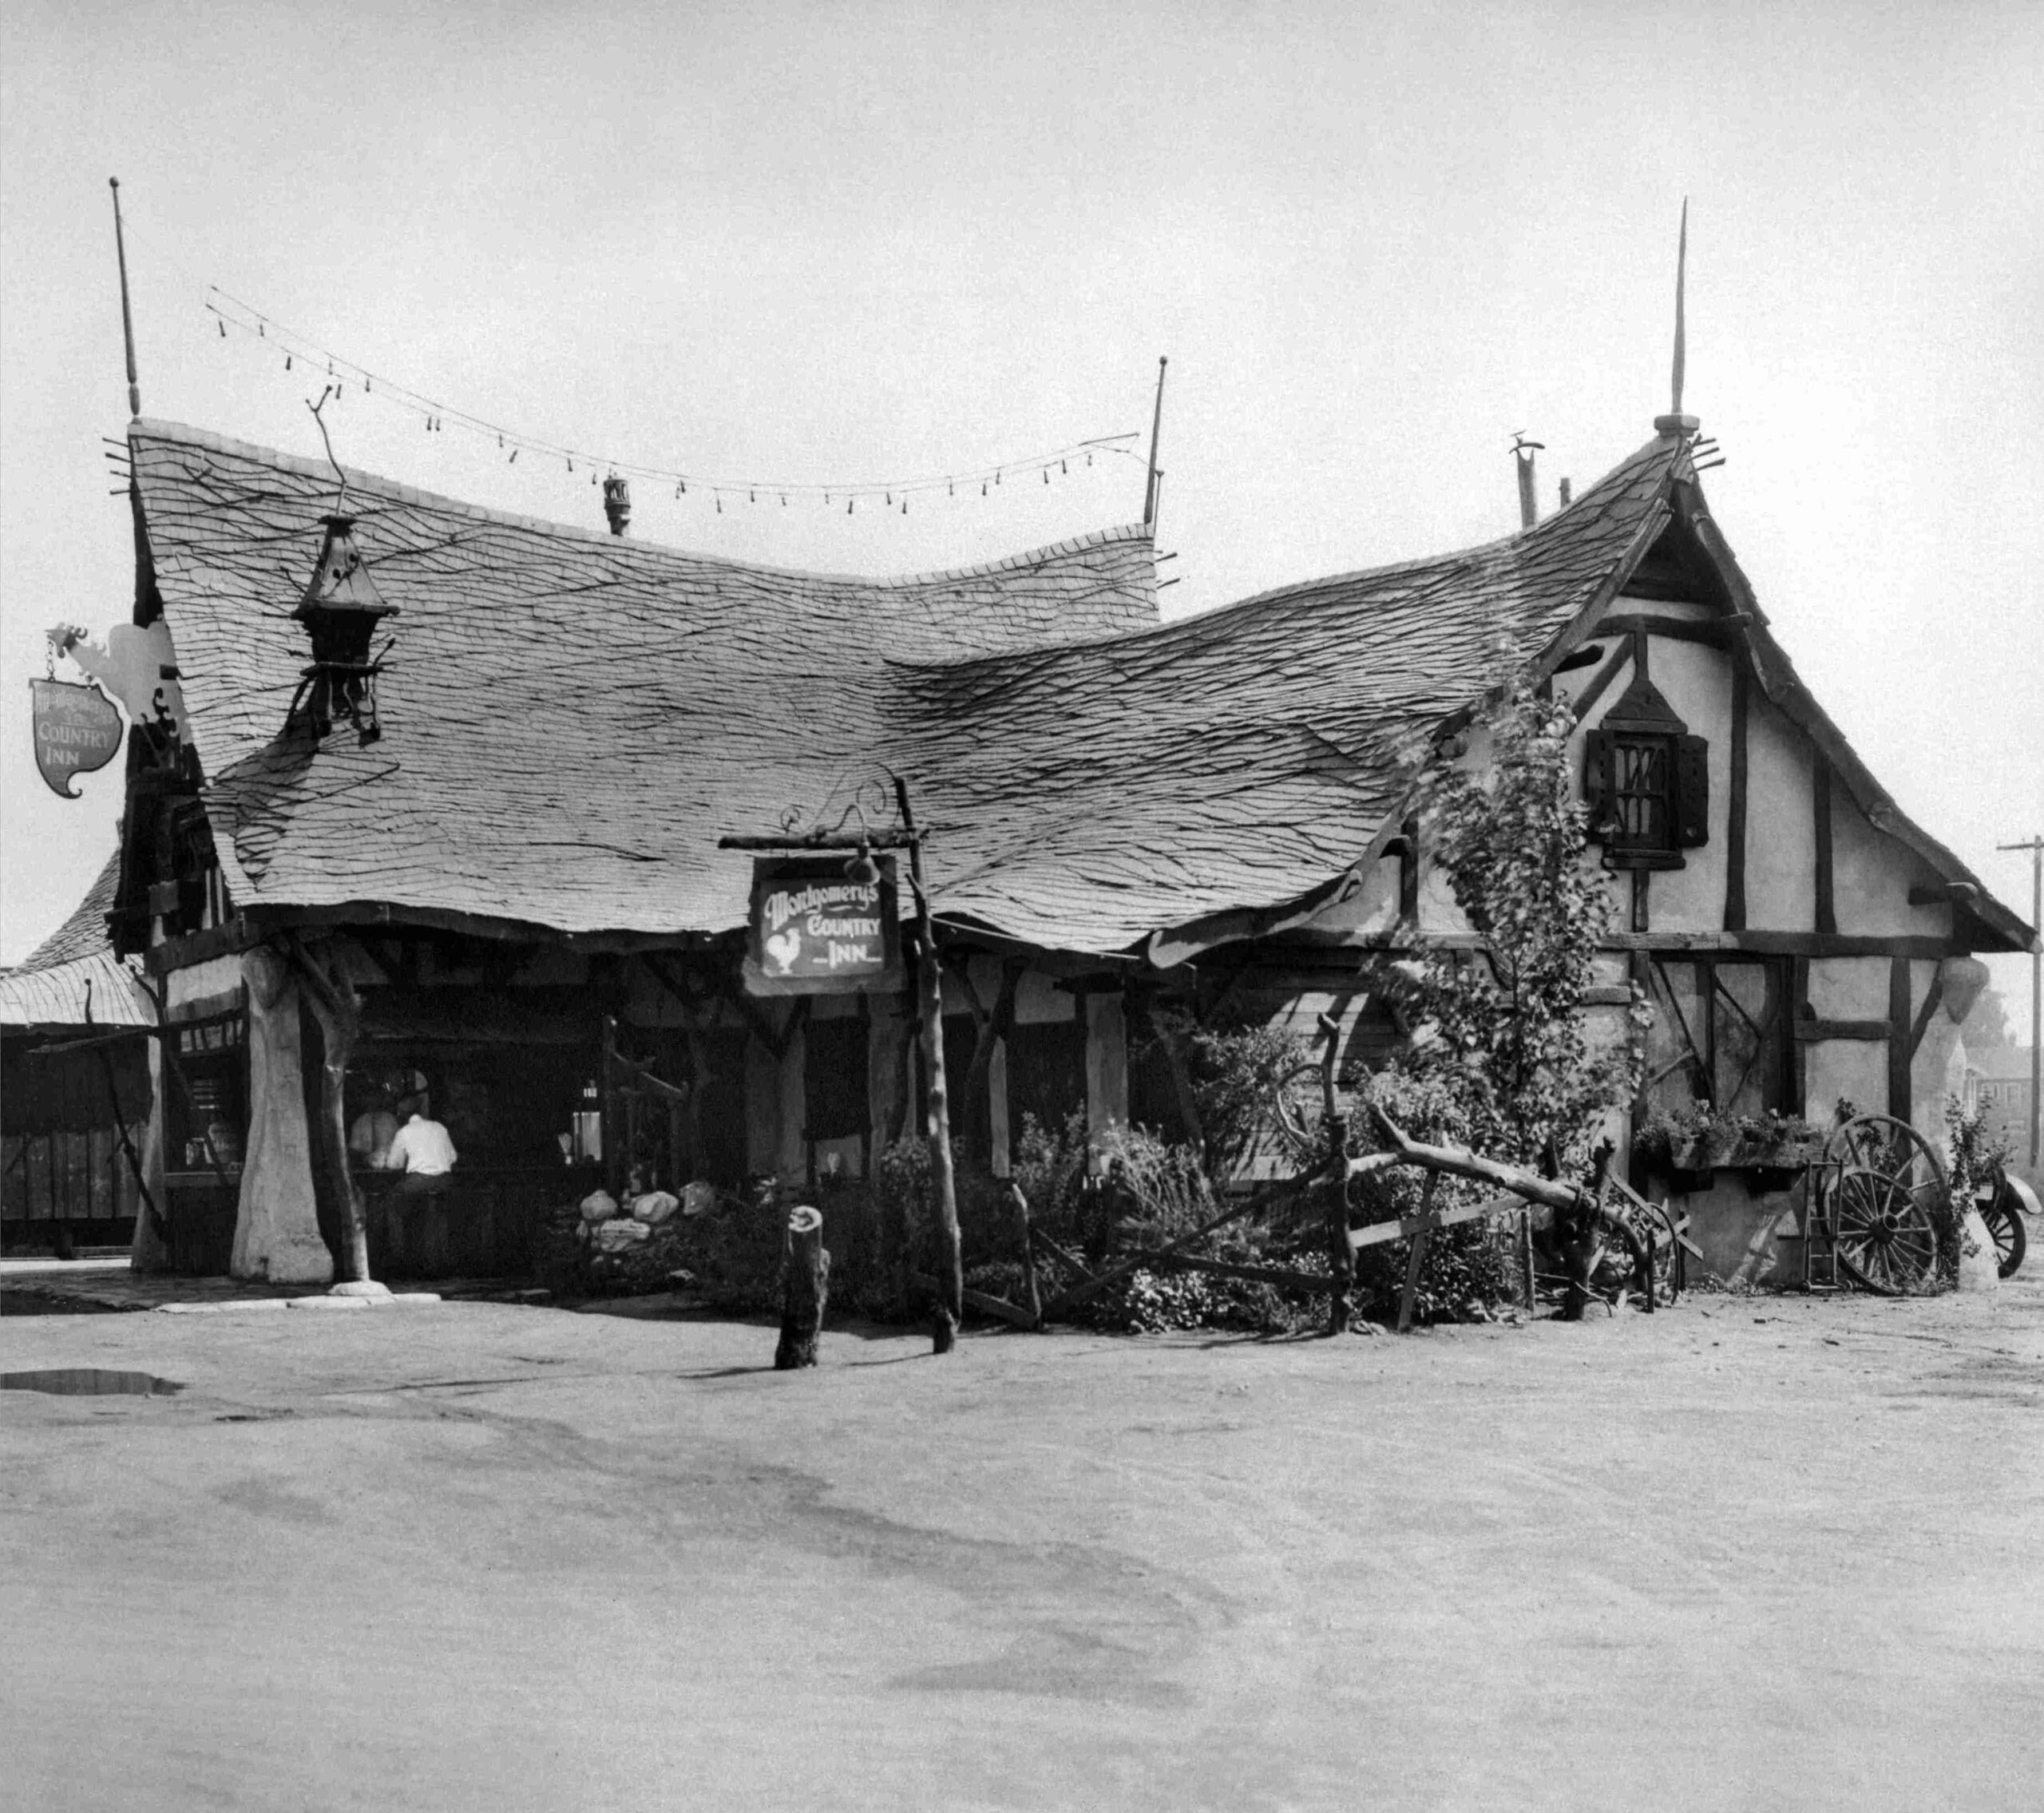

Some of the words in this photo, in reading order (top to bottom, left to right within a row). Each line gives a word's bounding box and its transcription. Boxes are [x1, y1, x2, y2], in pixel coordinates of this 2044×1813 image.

[38, 721, 113, 748] COUNTRY
[46, 746, 80, 766] INN
[807, 914, 881, 936] COUNTRY
[828, 940, 868, 969] INN
